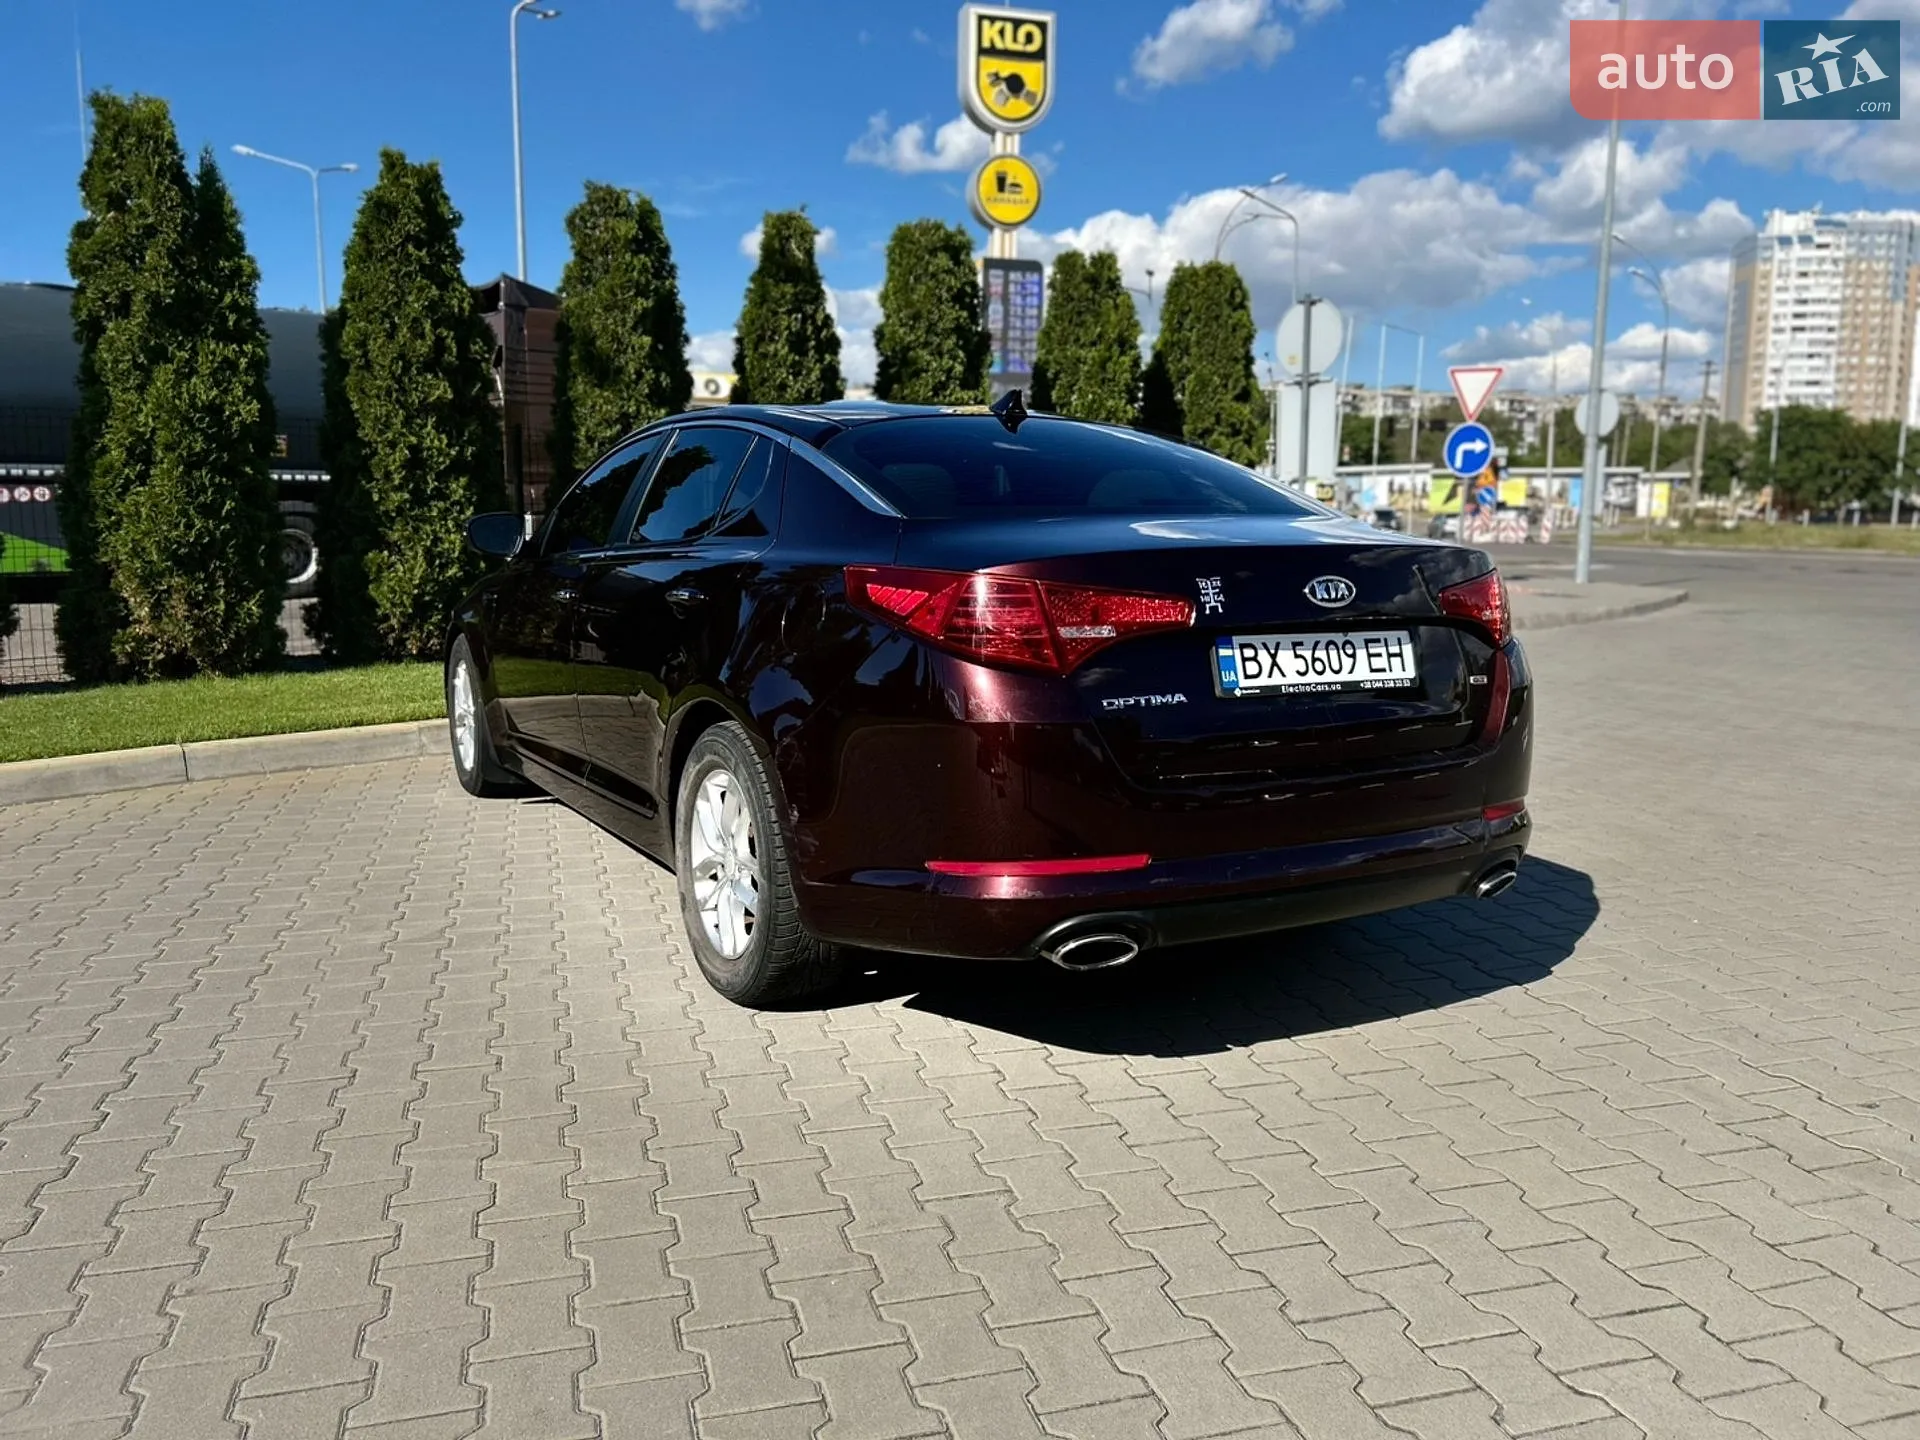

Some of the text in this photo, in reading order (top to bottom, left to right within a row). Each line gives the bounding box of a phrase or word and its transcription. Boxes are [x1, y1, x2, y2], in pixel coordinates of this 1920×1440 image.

[980, 18, 1043, 53] KLO
[1313, 581, 1350, 600] KIA
[1239, 637, 1405, 679] BX 5609 EH
[1221, 670, 1237, 682] UA
[1281, 684, 1342, 694] ElectroCars.ua
[1101, 693, 1188, 710] OPTIMA
